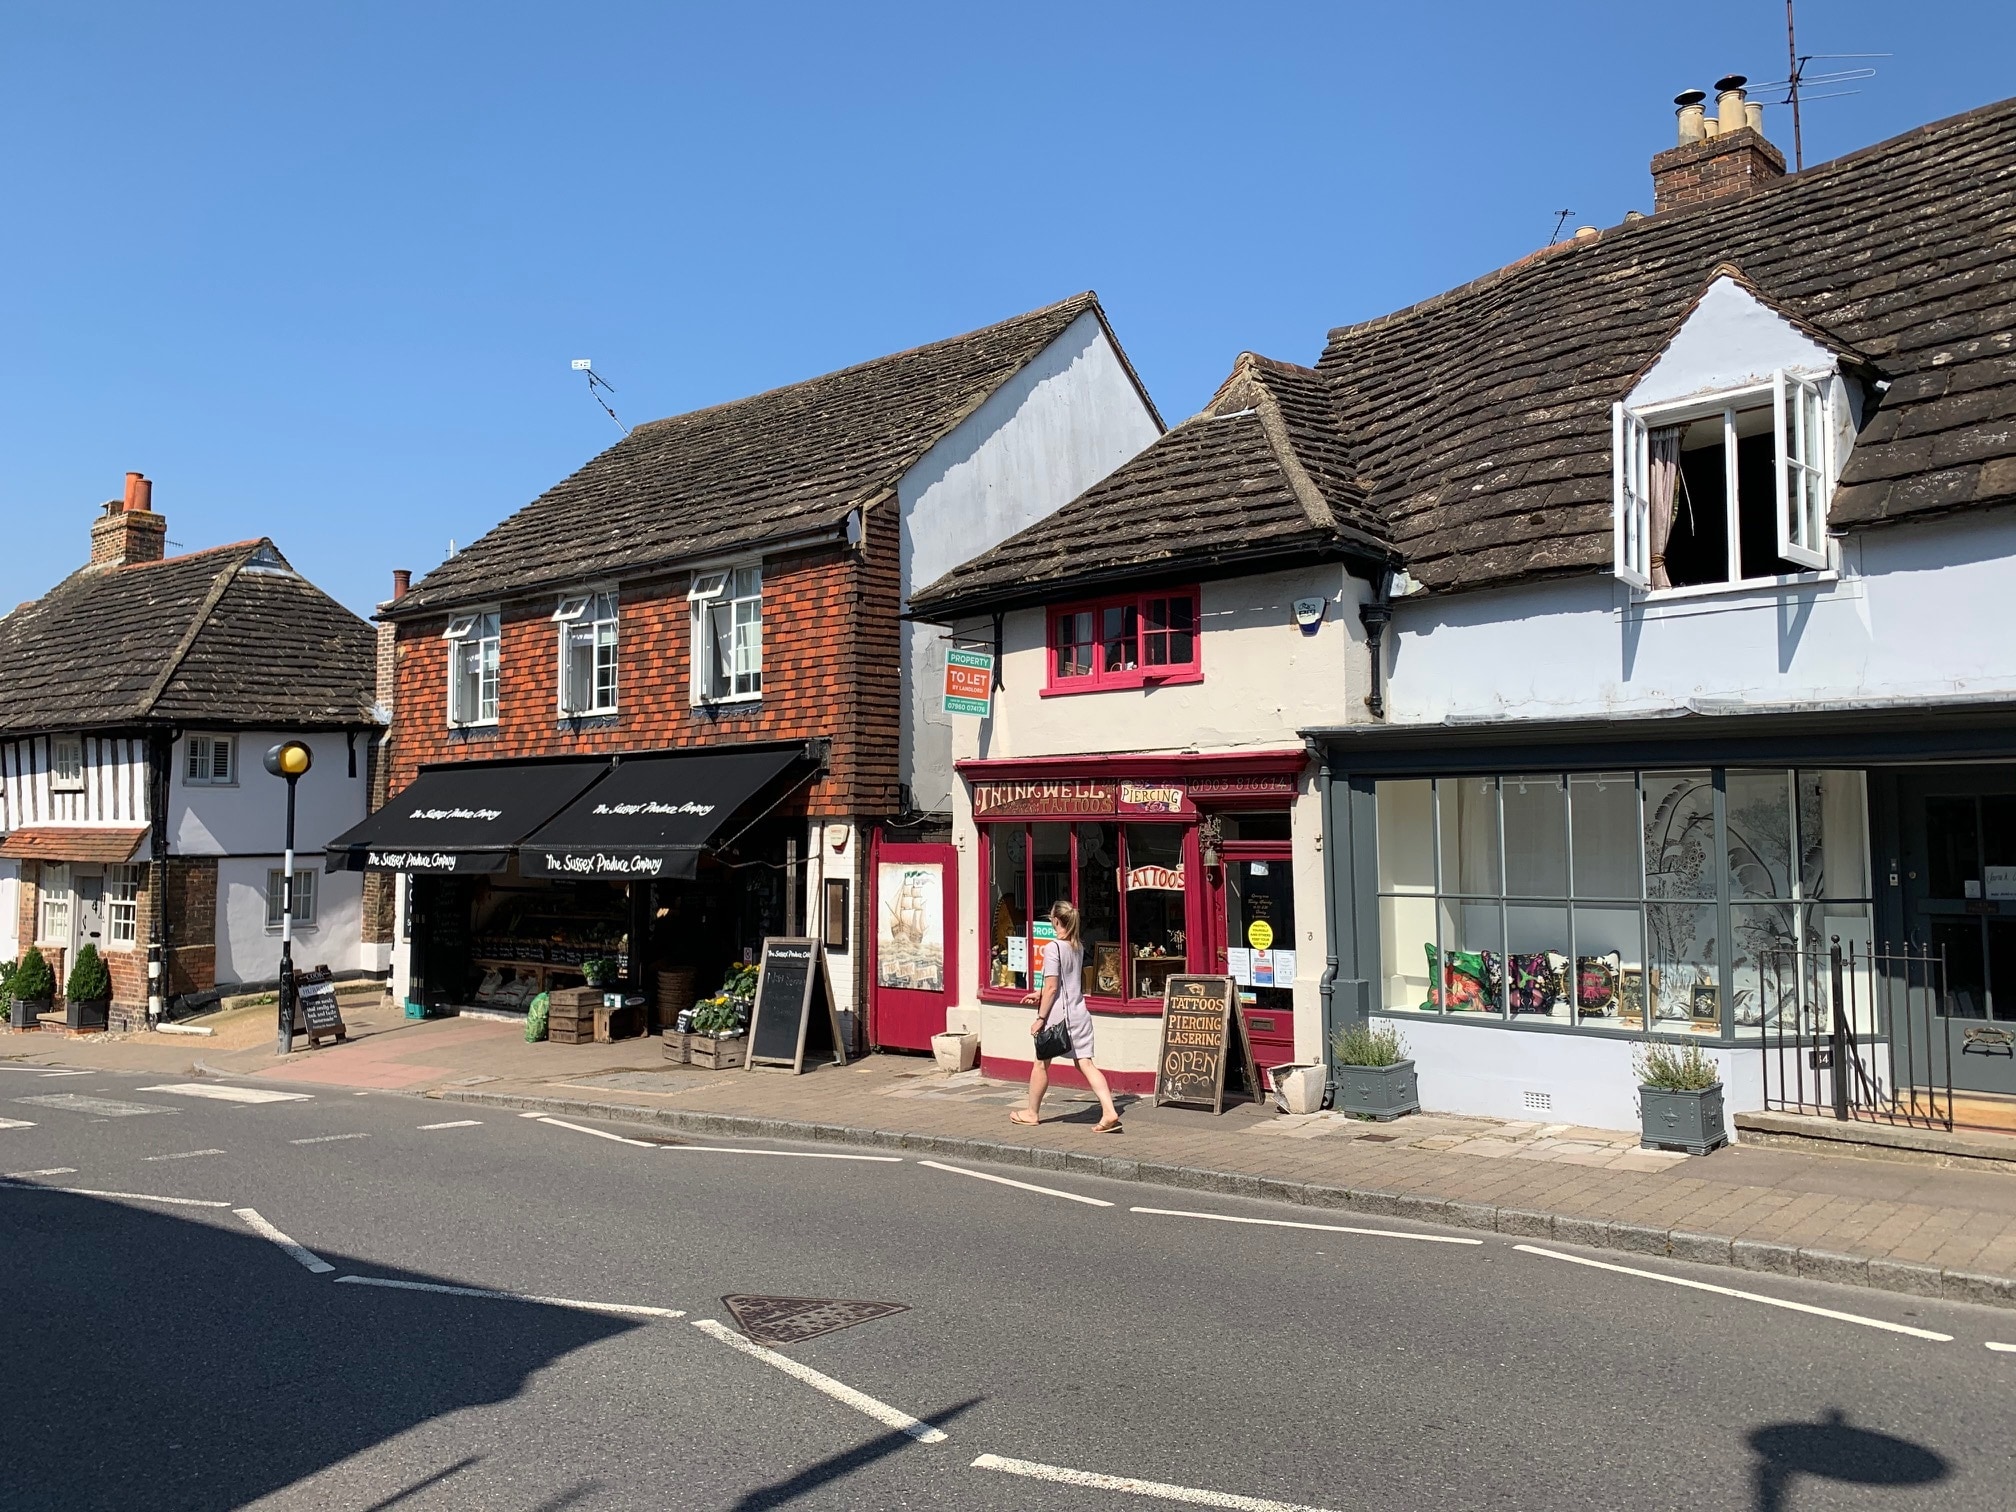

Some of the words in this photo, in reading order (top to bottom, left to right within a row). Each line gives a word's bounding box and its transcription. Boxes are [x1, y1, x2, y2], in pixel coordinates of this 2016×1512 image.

[950, 654, 988, 666] PROPERTY
[950, 671, 965, 683] TO
[967, 673, 987, 686] LET
[1192, 778, 1229, 792] 01903
[1236, 776, 1287, 791] 816614
[1122, 786, 1180, 804] PIERCING
[592, 803, 609, 815] The
[609, 802, 645, 815] Sussex
[643, 801, 677, 815] Produce
[1039, 797, 1114, 813] TATTOOS
[368, 852, 380, 865] The
[380, 852, 406, 868] Sussex
[405, 852, 432, 868] Produce
[546, 853, 562, 870] The
[563, 854, 595, 874] Sussex
[596, 853, 630, 873] Produce
[630, 854, 663, 876] Company
[1033, 926, 1057, 937] PROPE
[1170, 997, 1225, 1012] TATTOOS
[1168, 1015, 1222, 1031] PIERCING
[1167, 1031, 1221, 1046] LASERING
[1165, 1050, 1218, 1082] OPEN
